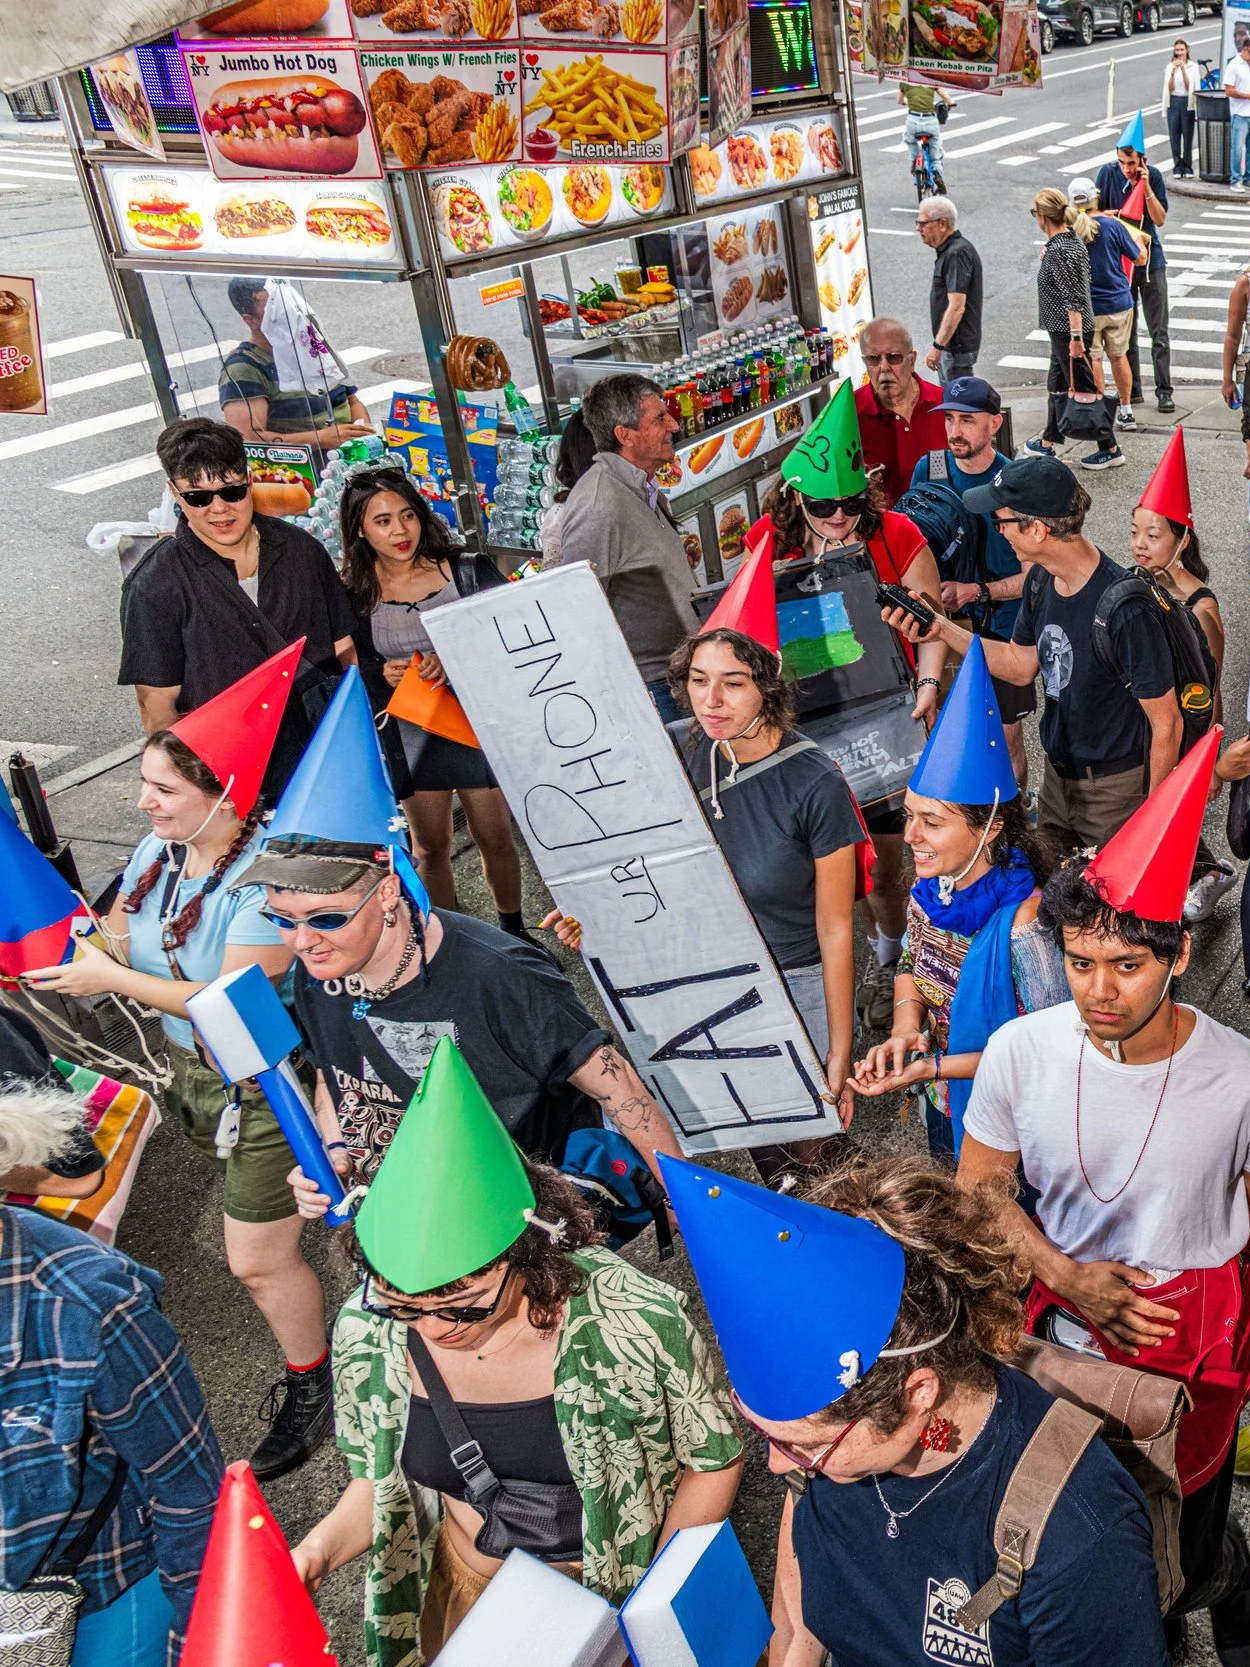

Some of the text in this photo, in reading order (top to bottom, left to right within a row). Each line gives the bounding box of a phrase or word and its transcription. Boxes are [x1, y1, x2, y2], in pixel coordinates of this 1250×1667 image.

[766, 11, 804, 72] W
[219, 54, 337, 73] Jumbo Hot Dog
[360, 52, 517, 69] Chicken Wings W/ French Fries
[908, 59, 935, 68] hicken
[937, 61, 963, 70] Kebab
[977, 63, 992, 72] Pita
[190, 65, 209, 76] NY
[521, 67, 542, 80] NY
[495, 83, 517, 96] NY
[571, 140, 662, 157] French Fries
[819, 185, 858, 204] JOHN'S FAMOUS
[824, 199, 856, 216] HALAL FOOD
[0, 347, 18, 360] ED
[245, 447, 266, 459] DOG
[492, 600, 683, 850] PHONE
[589, 957, 826, 1137] EAT
[331, 1066, 403, 1103] CKPARA
[949, 1590, 964, 1601] UAW
